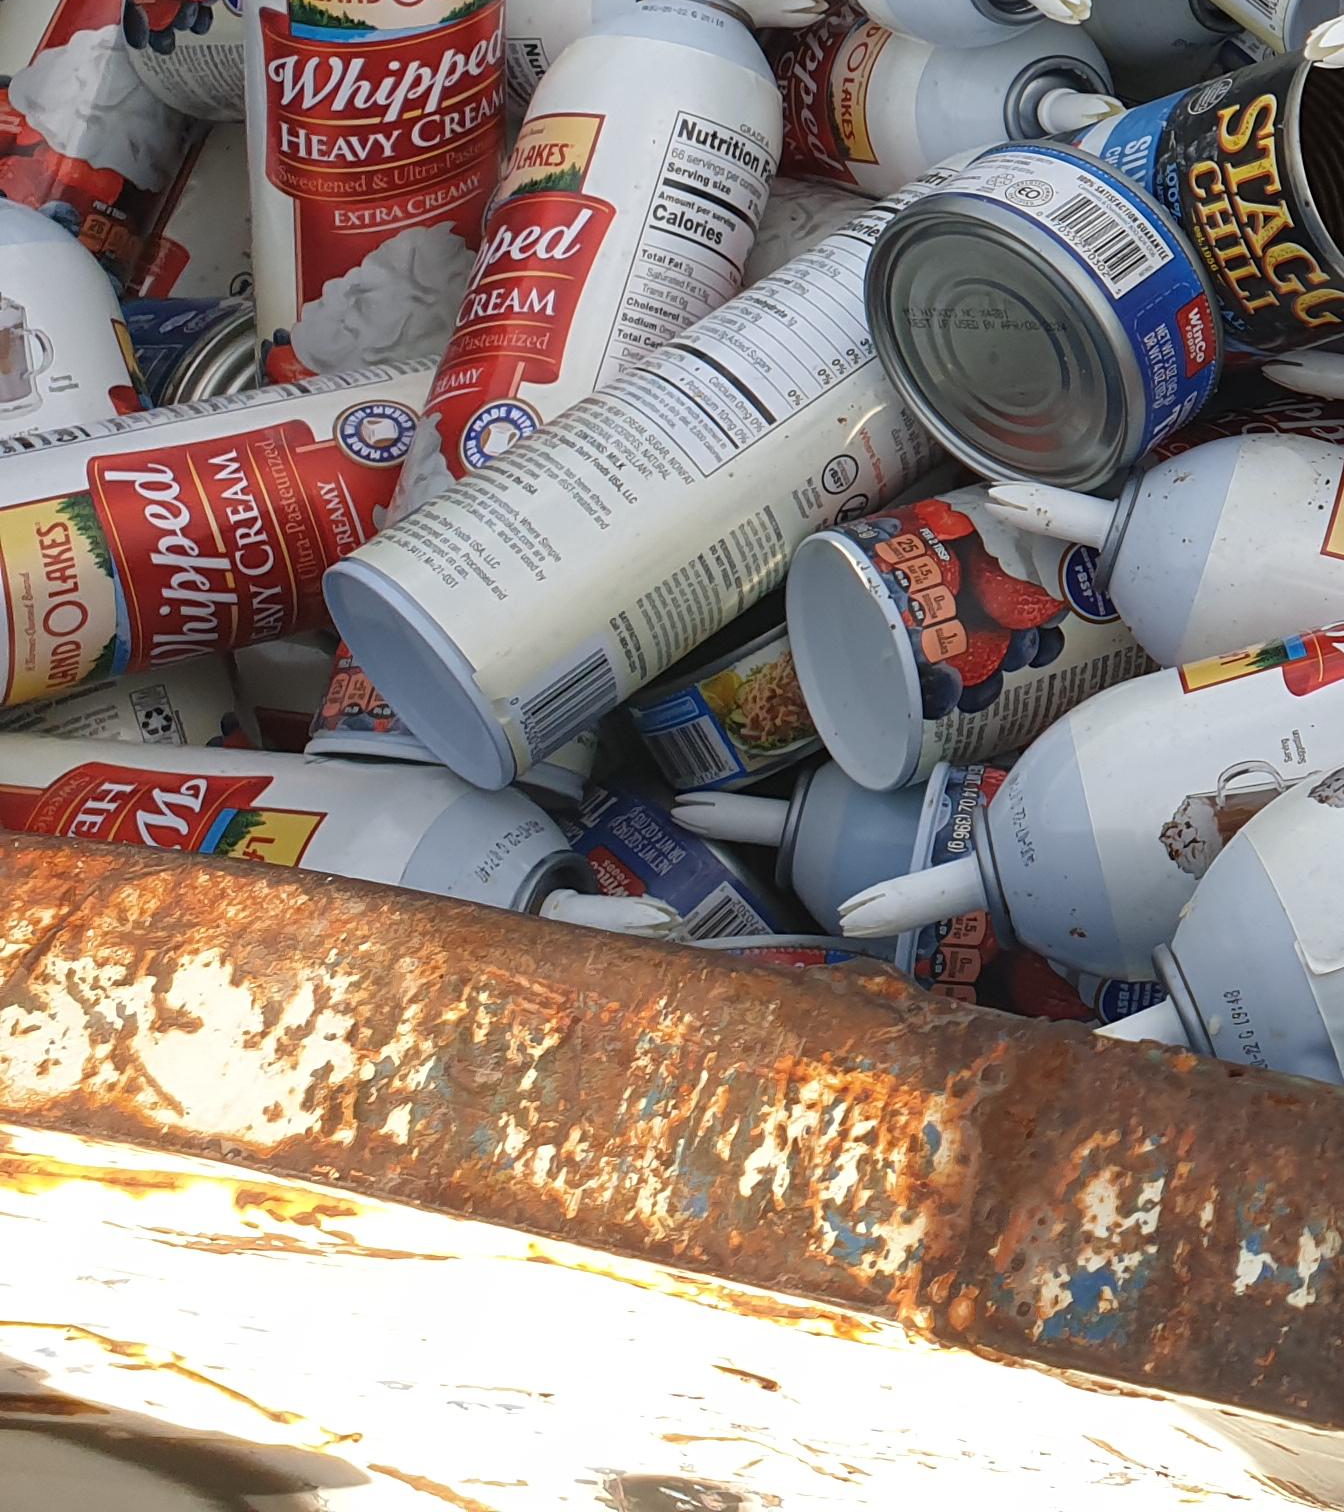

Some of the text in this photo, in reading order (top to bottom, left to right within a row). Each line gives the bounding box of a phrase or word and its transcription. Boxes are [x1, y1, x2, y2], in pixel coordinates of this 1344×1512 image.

[279, 123, 402, 161] HEAVY
[516, 143, 569, 169] LAKES
[677, 120, 762, 173] Nutrition
[276, 164, 367, 192] Sweetened
[334, 171, 480, 226] EXTRA CREAMY
[666, 162, 732, 195] Serving size
[652, 204, 723, 245] Calories
[1189, 161, 1279, 314] CHILI
[455, 287, 556, 327] CREAM
[1188, 307, 1208, 363] WinCo
[208, 447, 275, 576] CREAM
[35, 522, 78, 599] LAKES
